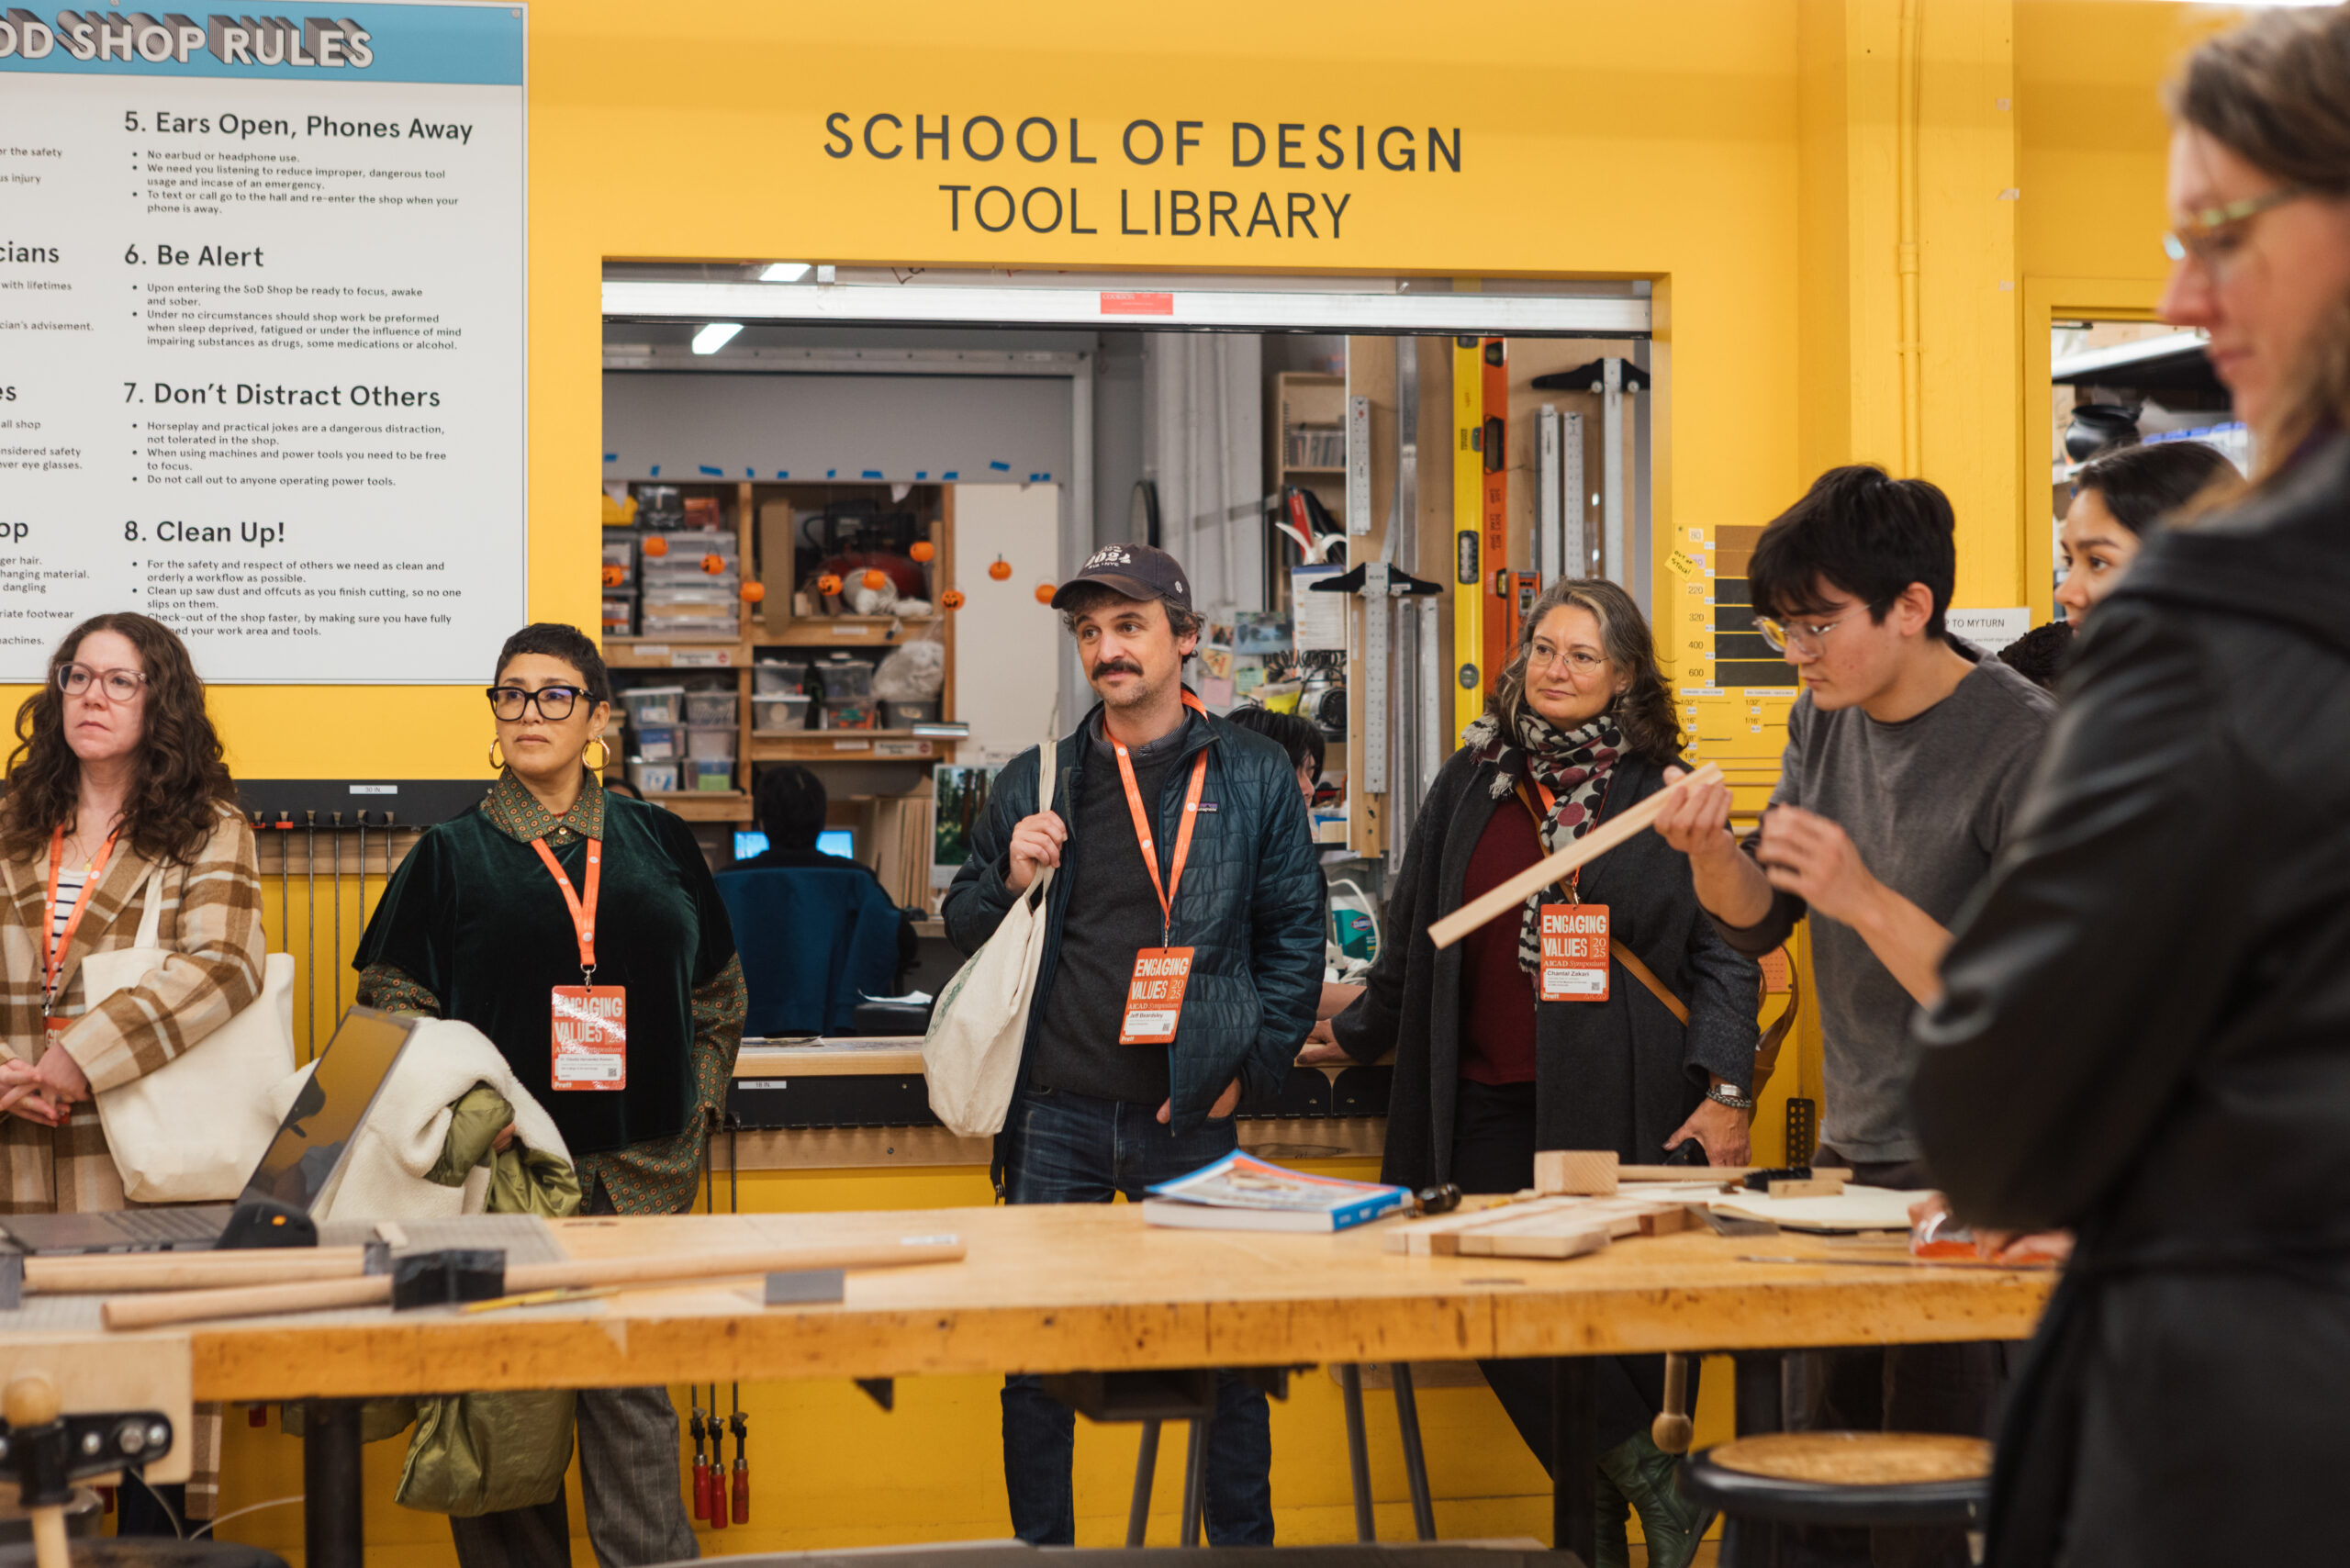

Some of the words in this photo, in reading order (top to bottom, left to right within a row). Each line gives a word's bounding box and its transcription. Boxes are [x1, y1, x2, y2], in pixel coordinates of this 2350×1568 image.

[60, 16, 207, 63] SHOP
[212, 19, 374, 68] RULES
[125, 110, 146, 132] 5.
[156, 111, 210, 134] Ears
[218, 113, 297, 140] Open,
[307, 115, 400, 138] Phones
[408, 118, 473, 145] Away
[823, 111, 1098, 165] SCHOOL
[1122, 118, 1204, 166] OF
[1232, 121, 1463, 173] DESIGN
[9, 146, 28, 156] the
[30, 147, 62, 159] safety
[147, 150, 162, 160] No
[164, 151, 201, 161] earbud
[218, 151, 276, 163] headphone
[147, 162, 163, 173] We
[166, 163, 192, 174] need
[195, 166, 214, 175] you
[217, 164, 260, 177] listening
[262, 166, 274, 175] to
[275, 166, 313, 176] reduce
[315, 166, 365, 179] improper,
[369, 168, 422, 180] dangerous
[424, 170, 445, 179] tool
[147, 203, 180, 214] phone
[183, 204, 191, 213] is
[193, 206, 222, 216] away.
[938, 185, 1098, 235] TOOL
[1120, 188, 1352, 240] LIBRARY
[124, 243, 147, 264] 6.
[158, 244, 189, 265] Be
[197, 245, 263, 267] Alert
[0, 280, 24, 289] with
[27, 280, 73, 291] lifetimes
[147, 283, 174, 294] Upon
[177, 284, 221, 296] entering
[223, 284, 241, 294] the
[243, 285, 264, 294] SoD
[266, 285, 293, 297] Shop
[296, 286, 308, 295] be
[311, 286, 341, 297] ready
[342, 286, 354, 296] to
[356, 286, 387, 297] focus,
[391, 287, 422, 297] awake
[147, 297, 166, 306] and
[169, 297, 201, 306] sober.
[123, 382, 143, 403] 7.
[154, 382, 227, 405] Don't
[237, 383, 341, 406] Distract
[350, 385, 441, 407] Others
[0, 419, 13, 429] all
[15, 420, 40, 431] shop
[147, 421, 199, 433] Horseplay
[201, 421, 220, 431] and
[223, 422, 269, 433] practical
[271, 422, 298, 434] jokes
[329, 423, 383, 435] dangerous
[385, 423, 444, 435] distraction,
[147, 435, 164, 444] not
[167, 434, 216, 444] tolerated
[218, 435, 229, 444] in
[230, 435, 249, 444] the
[252, 436, 279, 447] shop.
[50, 447, 81, 458] safety
[21, 462, 40, 470] eye
[147, 474, 162, 484] Do
[164, 475, 182, 484] not
[185, 475, 203, 484] call
[205, 476, 223, 484] out
[226, 476, 238, 485] to
[240, 477, 277, 487] anyone
[279, 476, 330, 487] operating
[331, 478, 364, 487] power
[367, 476, 396, 486] tools.
[124, 520, 147, 542] 8.
[156, 521, 230, 543] Clean
[241, 521, 284, 548] Up!
[147, 559, 164, 568] For
[167, 559, 185, 568] the
[187, 560, 218, 571] safety
[221, 560, 241, 569] and
[243, 561, 283, 571] respect
[285, 560, 297, 569] of
[299, 561, 333, 570] others
[353, 561, 379, 570] need
[396, 561, 423, 570] clean
[426, 561, 444, 570] and
[2, 582, 46, 594] dangling
[1688, 586, 1704, 595] 220
[26, 609, 74, 619] footwear
[1689, 612, 1705, 622] 320
[1953, 619, 1964, 628] TO
[1966, 619, 2005, 628] MYTURN
[1688, 641, 1704, 649] 400
[1688, 668, 1704, 678] 600
[1543, 914, 1606, 934] ENGAGING
[1543, 937, 1588, 957] VALUES
[1593, 937, 1606, 947] 20
[1593, 947, 1606, 958] 25
[1135, 958, 1189, 977] ENGAGING
[1131, 980, 1169, 1000] VALUES
[1170, 979, 1184, 989] 20
[1169, 990, 1181, 1000] 25
[554, 1021, 602, 1043] VALUES
